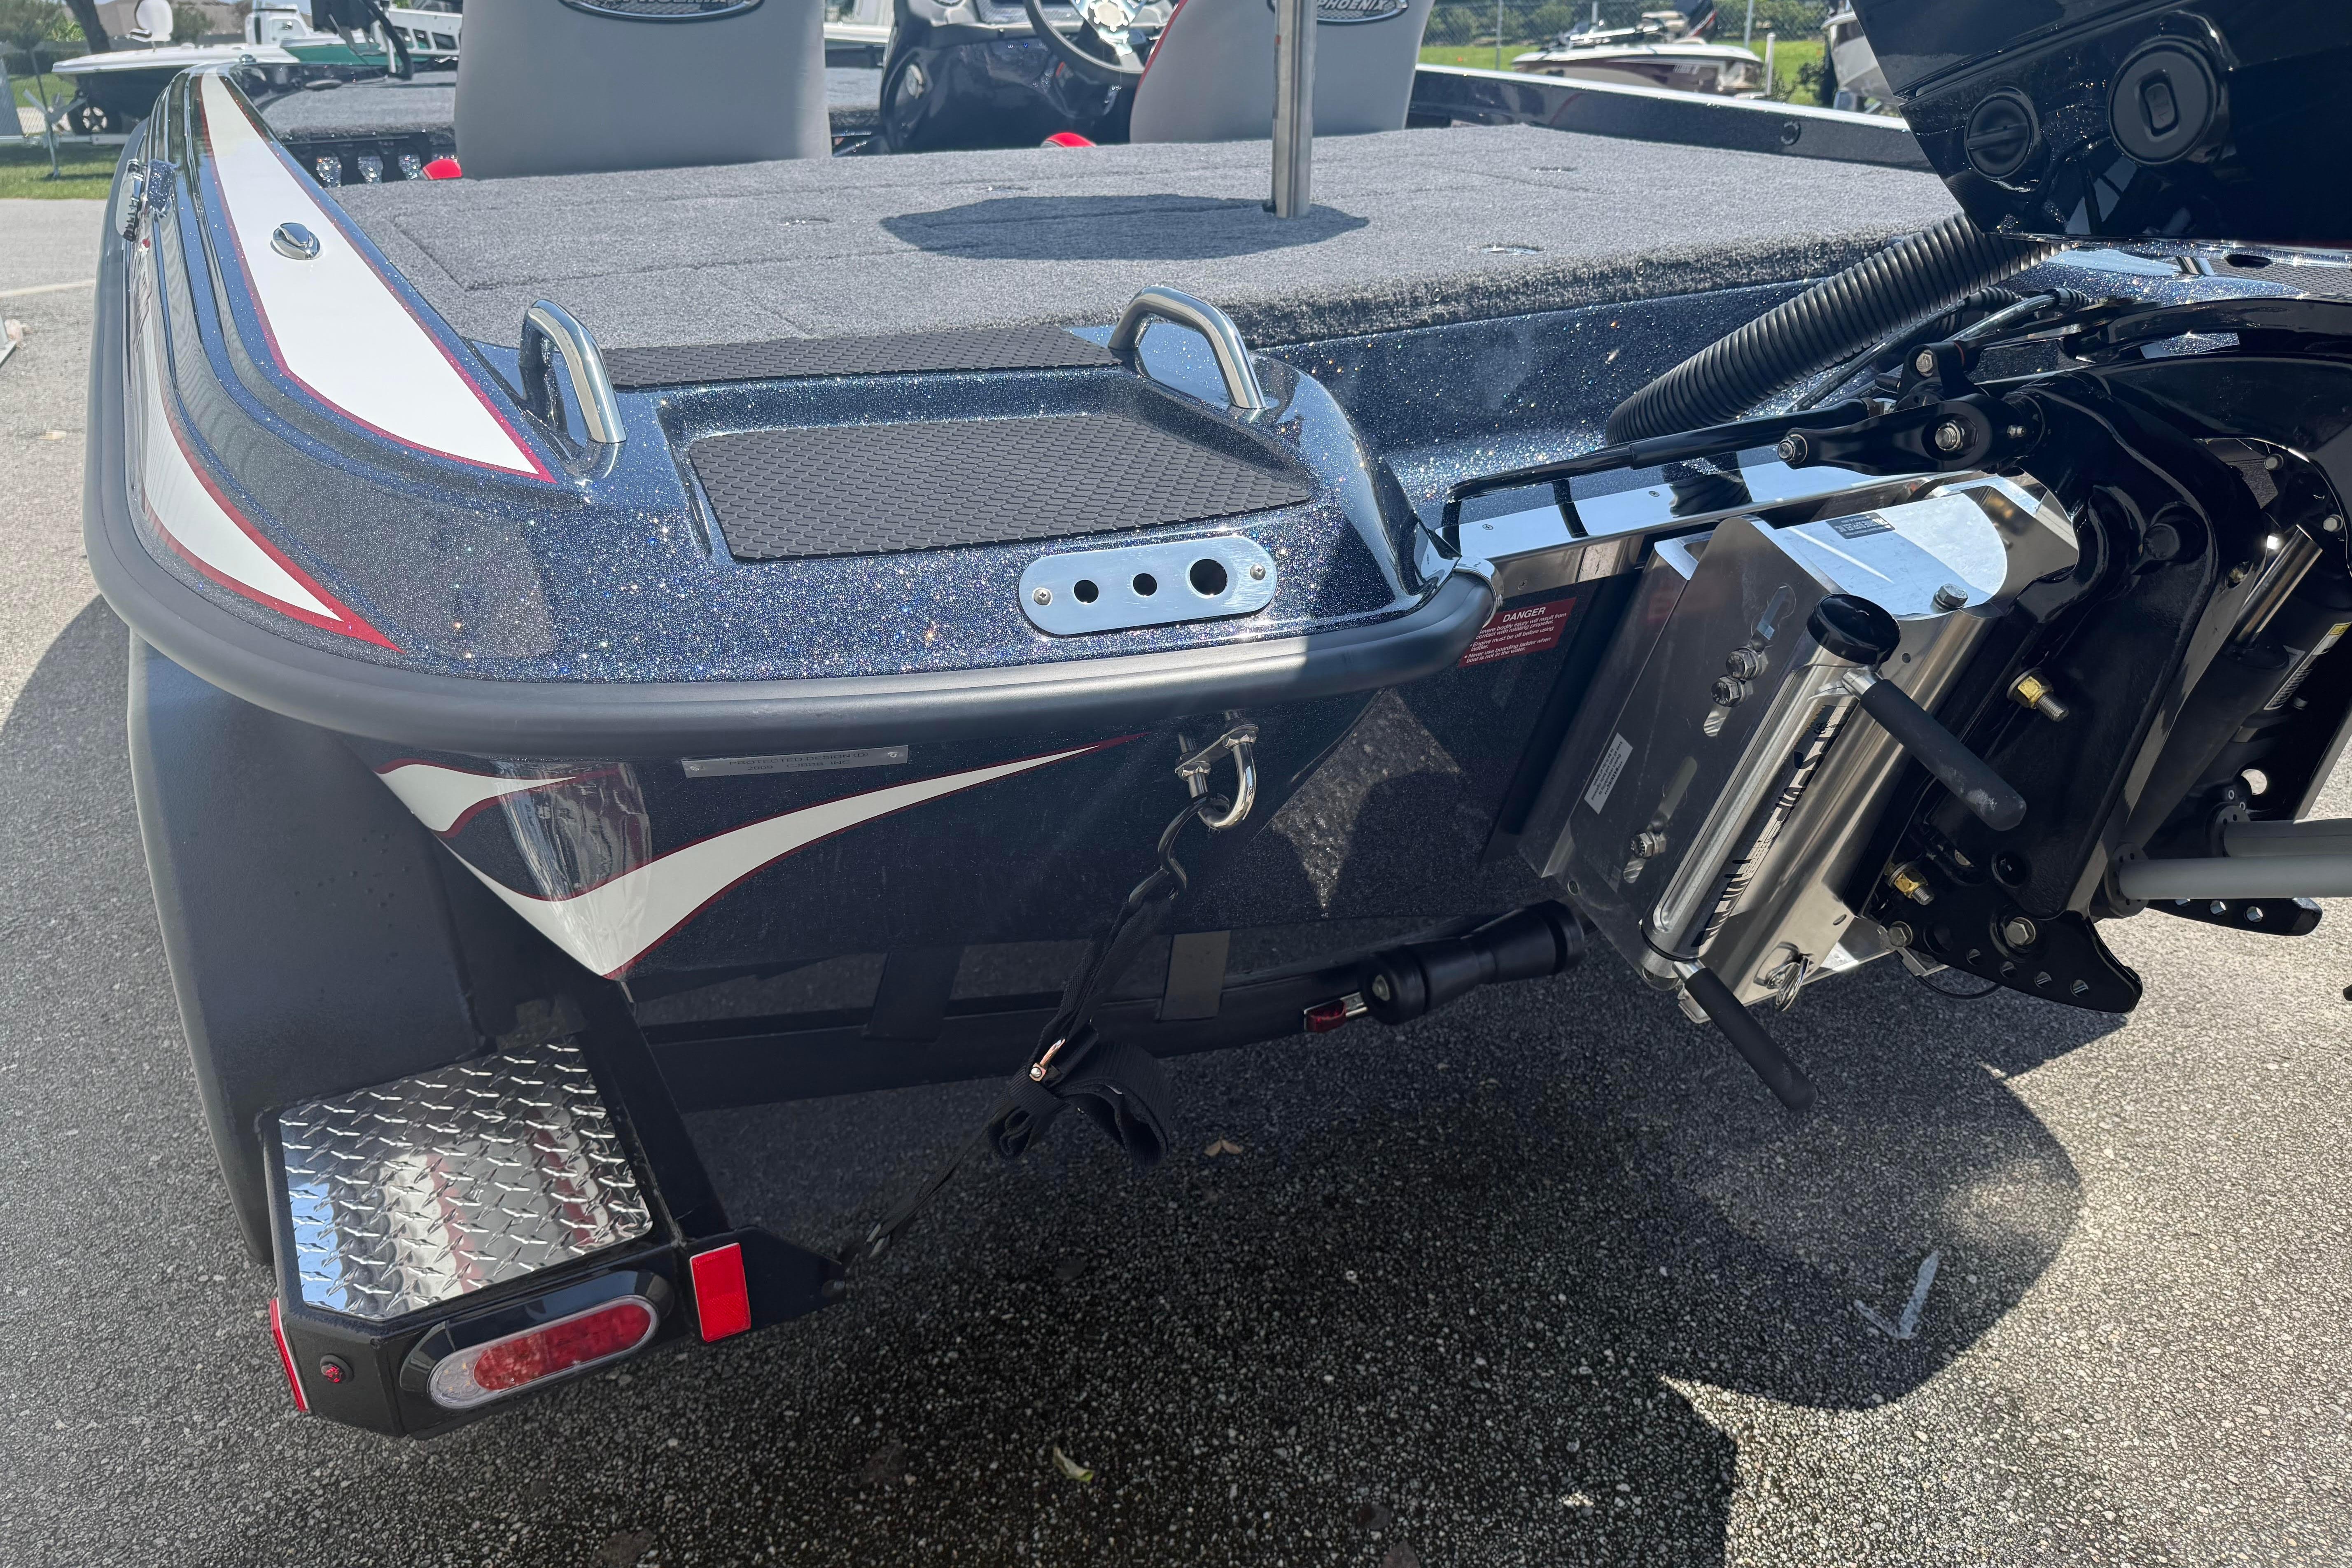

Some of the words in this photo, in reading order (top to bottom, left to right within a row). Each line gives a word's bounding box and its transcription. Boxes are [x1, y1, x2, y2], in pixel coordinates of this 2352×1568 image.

[1317, 0, 1388, 10] PHOENIX
[1502, 607, 1547, 622] DANGER
[1475, 631, 1496, 639] contact
[1508, 625, 1530, 633] rotating
[1529, 619, 1554, 628] propeller.
[1496, 623, 1514, 631] bodily
[1513, 620, 1529, 628] injury
[1472, 639, 1492, 647] Engine
[1494, 644, 1519, 653] boarding
[729, 757, 803, 765] PROTECTED
